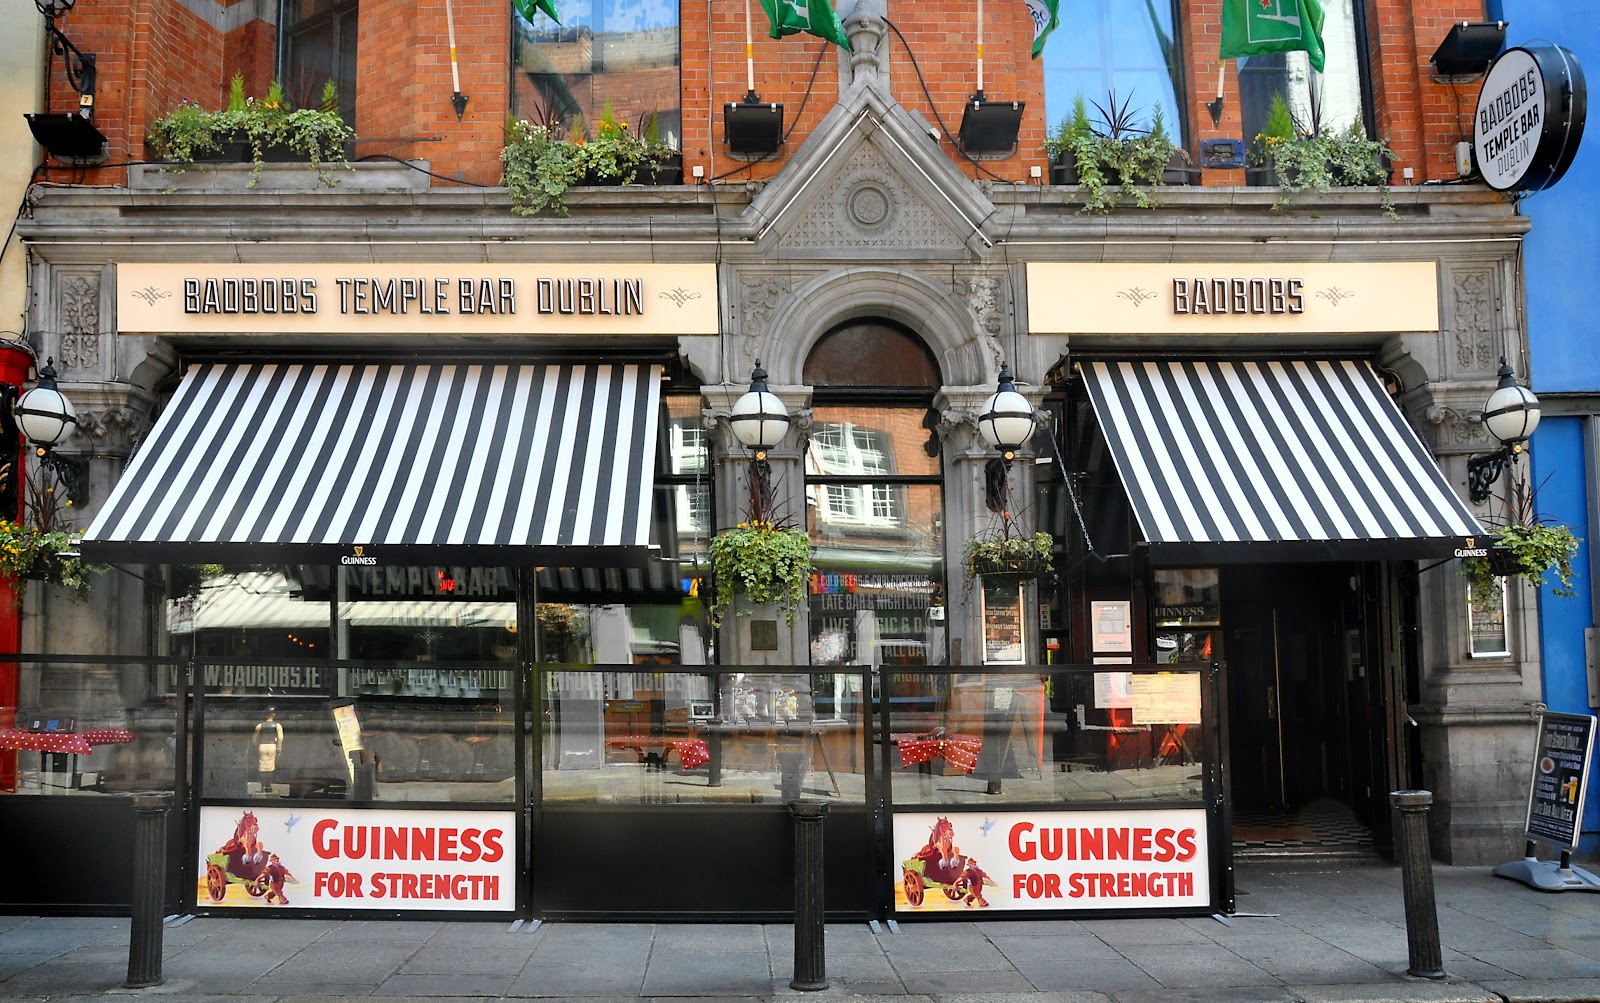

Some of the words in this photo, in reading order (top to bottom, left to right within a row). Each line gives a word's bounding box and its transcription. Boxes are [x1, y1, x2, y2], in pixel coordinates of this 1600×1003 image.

[1480, 67, 1536, 136] BADBOBS
[1483, 119, 1518, 163] TEMPLE
[1521, 103, 1540, 137] BAR
[1497, 137, 1529, 176] DUBLIN
[184, 278, 317, 314] BADBOBS
[335, 278, 450, 314] TEMPLE
[458, 278, 515, 315] BAR
[537, 278, 643, 315] DUBLIN
[1173, 278, 1305, 314] BADBOBS
[341, 555, 377, 565] GUINNESS
[1454, 548, 1488, 557] GUINNESS
[361, 567, 446, 595] TEMPLE
[454, 567, 498, 596] BAR
[822, 594, 843, 610] LATE
[846, 594, 863, 610] BAR
[1155, 606, 1205, 616] UINNESS
[170, 664, 320, 688] WW.BADBOBS.IE
[312, 819, 504, 862] GUINNESS
[1008, 822, 1198, 862] GUINNESS
[314, 872, 363, 898] FOR
[369, 872, 499, 900] STRENGTH
[1013, 873, 1063, 898] FOR
[1068, 872, 1193, 897] STRENGTH
